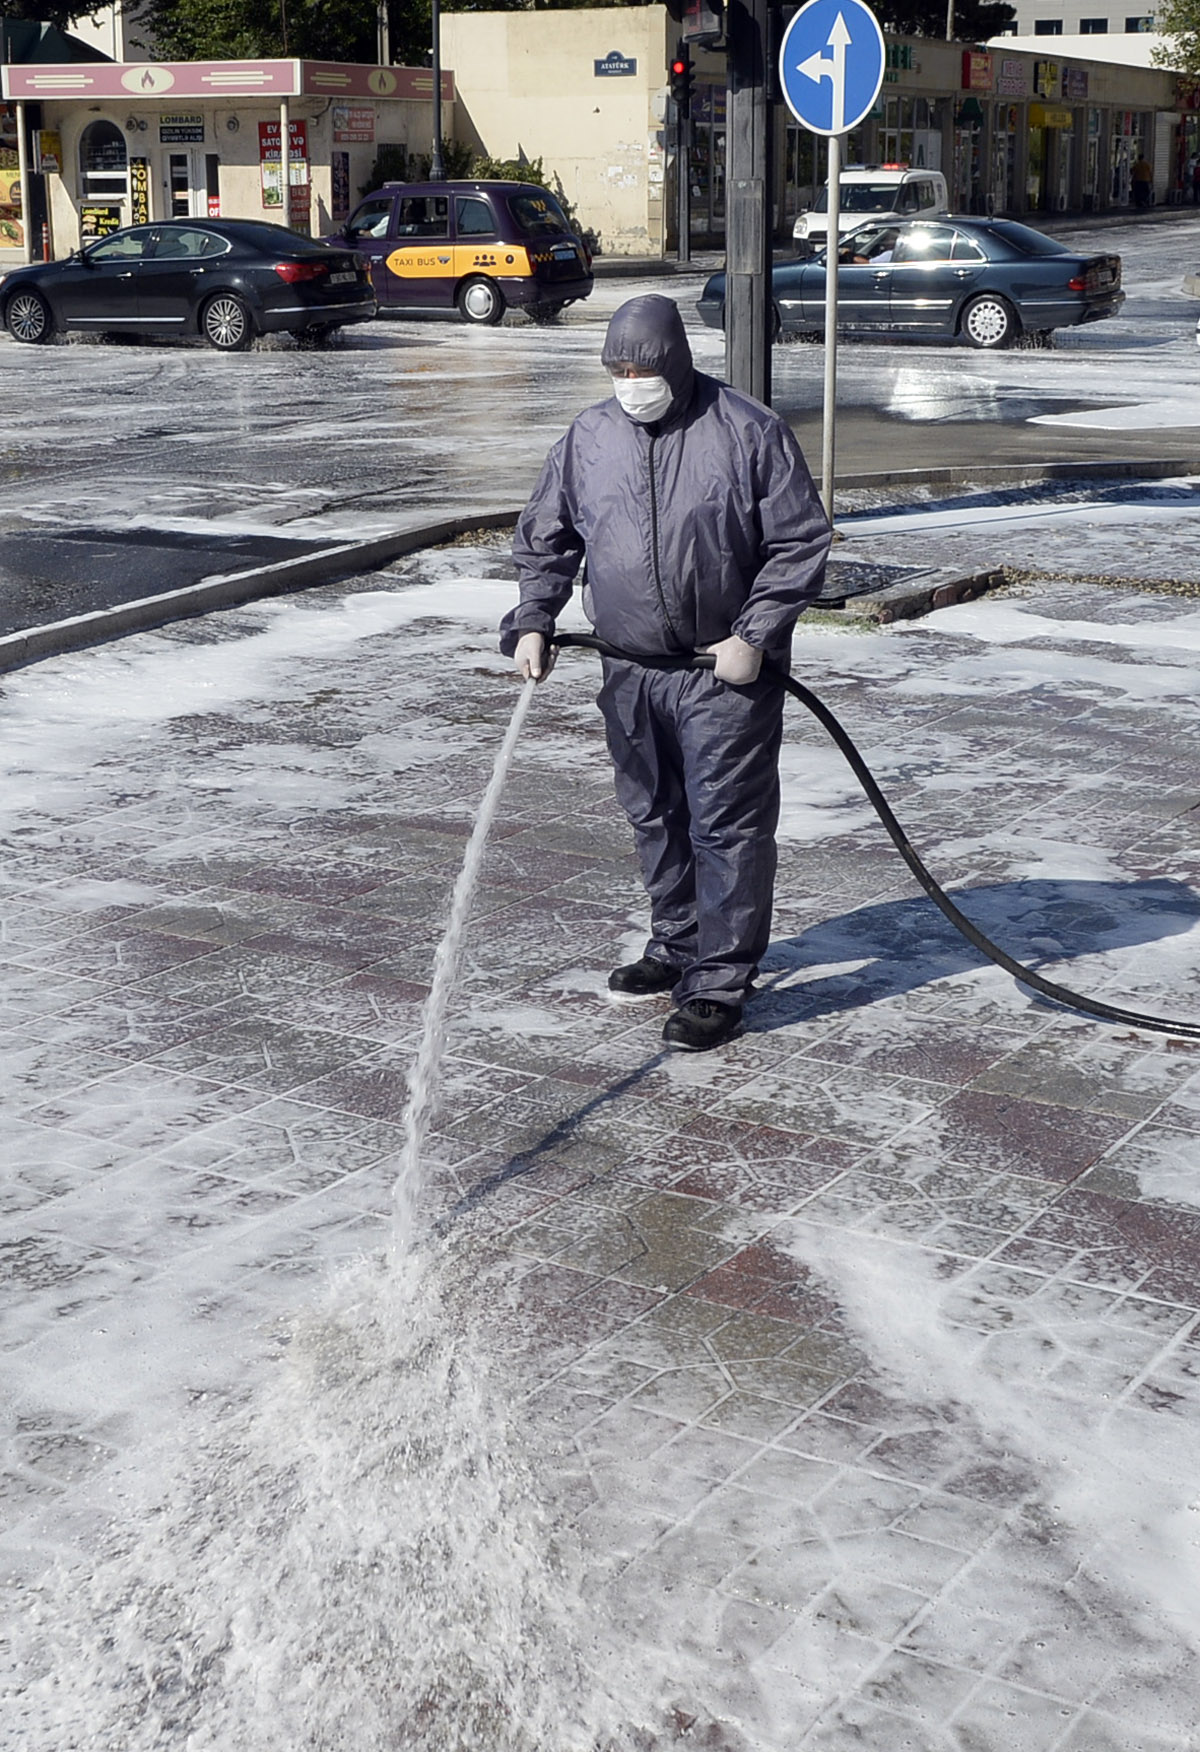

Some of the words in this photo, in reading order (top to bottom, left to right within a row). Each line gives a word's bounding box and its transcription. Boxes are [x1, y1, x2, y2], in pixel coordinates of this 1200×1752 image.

[600, 61, 629, 70] ATATÜRK
[160, 116, 202, 124] LOMBARD
[267, 124, 277, 134] EV
[394, 258, 414, 266] TAXI
[417, 257, 436, 266] BUS
